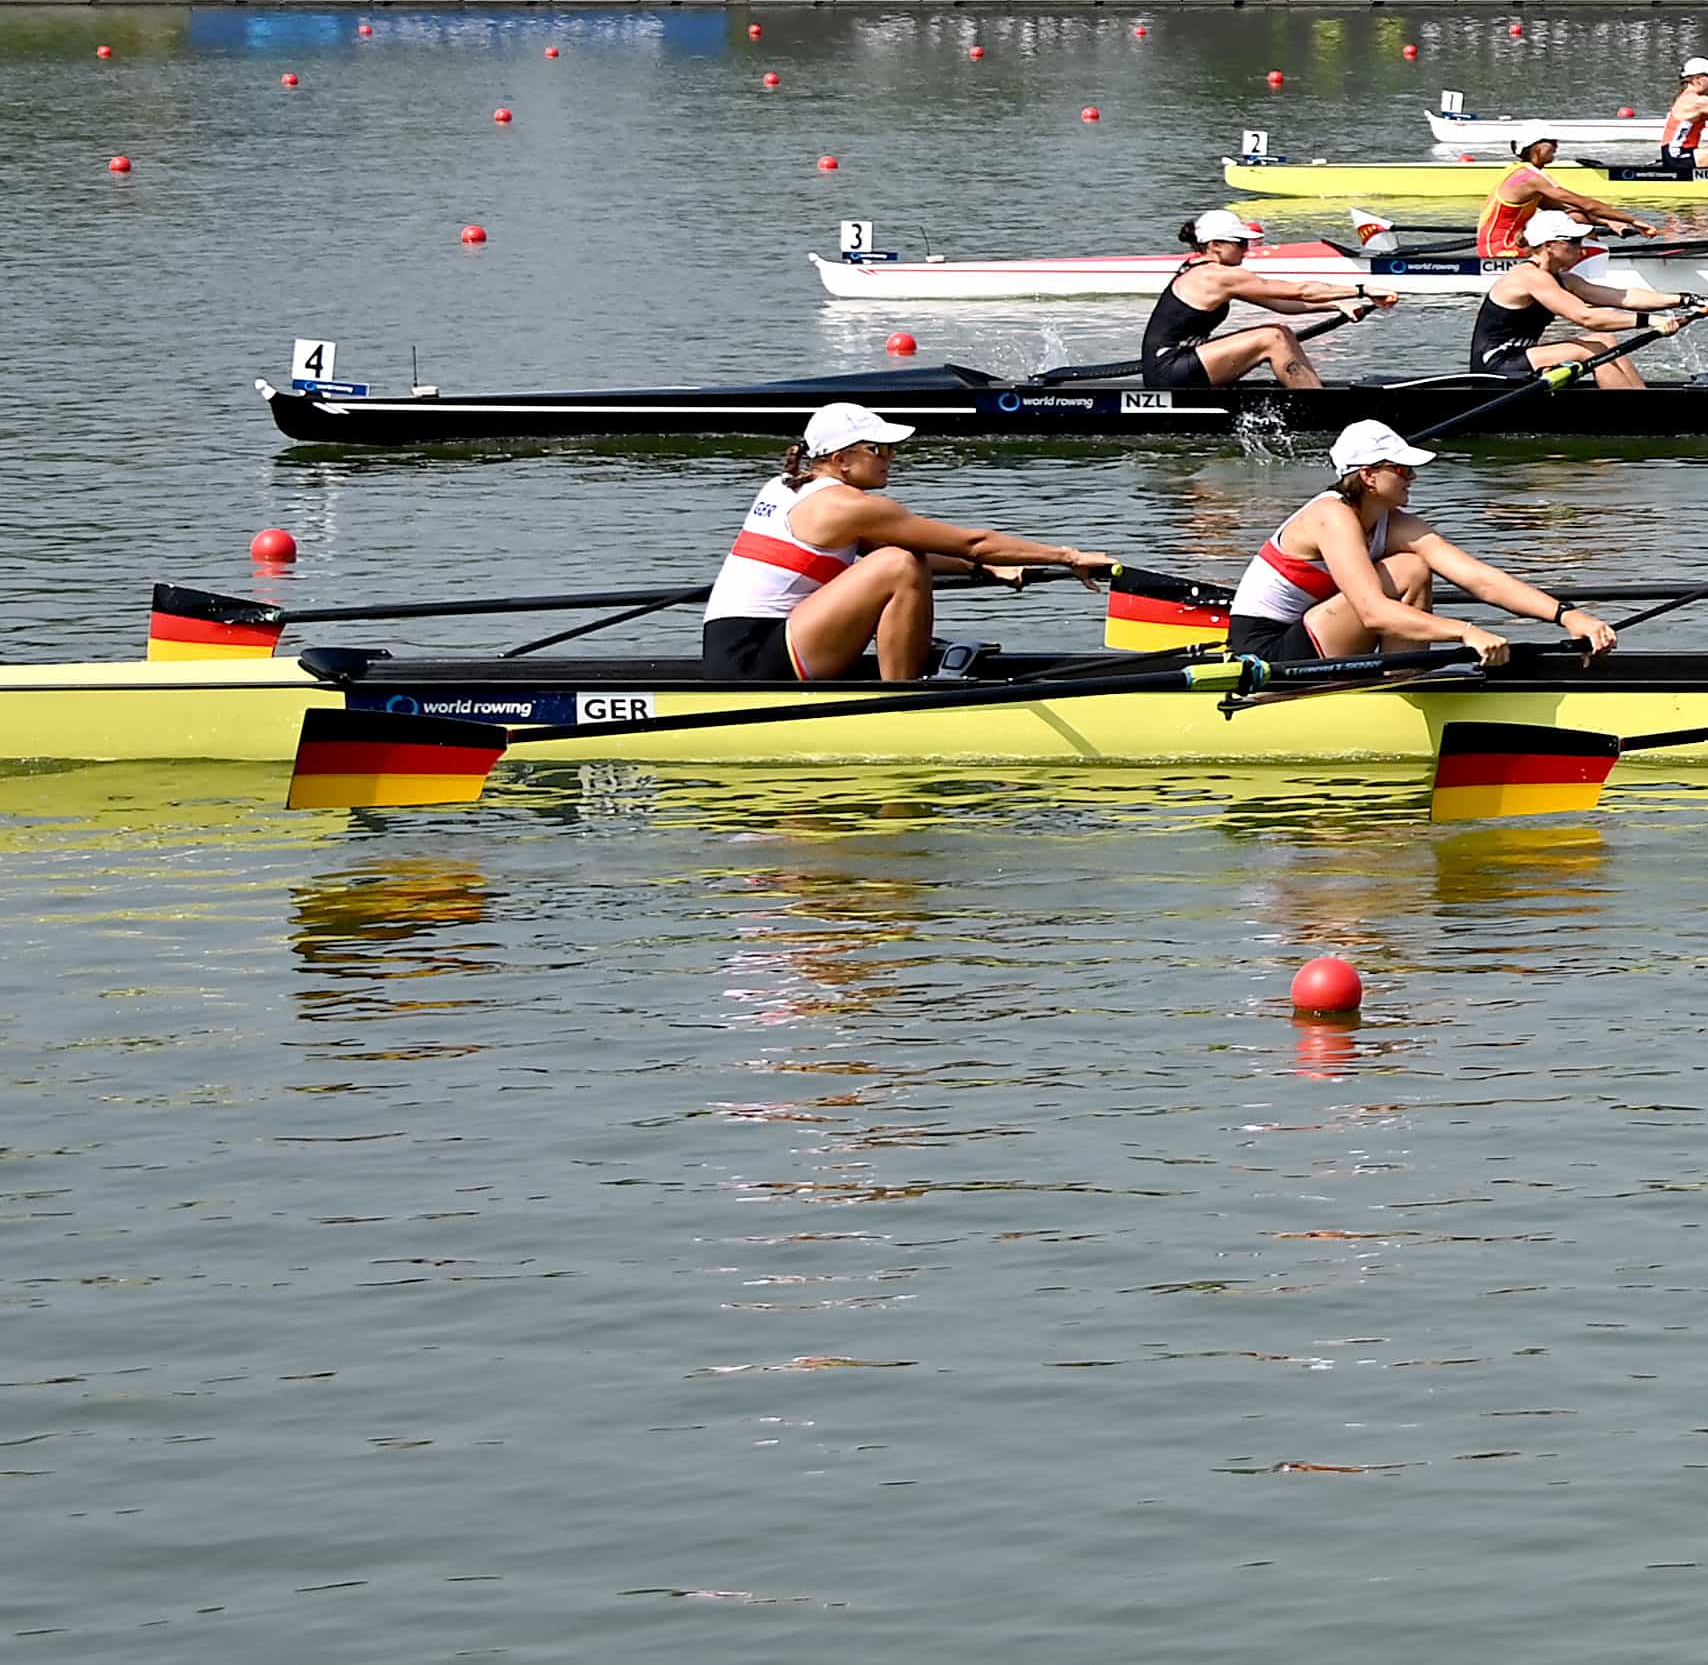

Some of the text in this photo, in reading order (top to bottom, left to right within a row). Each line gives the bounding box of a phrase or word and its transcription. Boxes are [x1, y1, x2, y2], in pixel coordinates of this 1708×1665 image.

[1251, 133, 1260, 153] 2
[850, 223, 862, 250] 3
[305, 344, 324, 379] 4
[1022, 395, 1094, 410] world rowing
[1126, 394, 1168, 408] NZL
[424, 700, 533, 718] world rowing
[584, 698, 650, 721] GER
